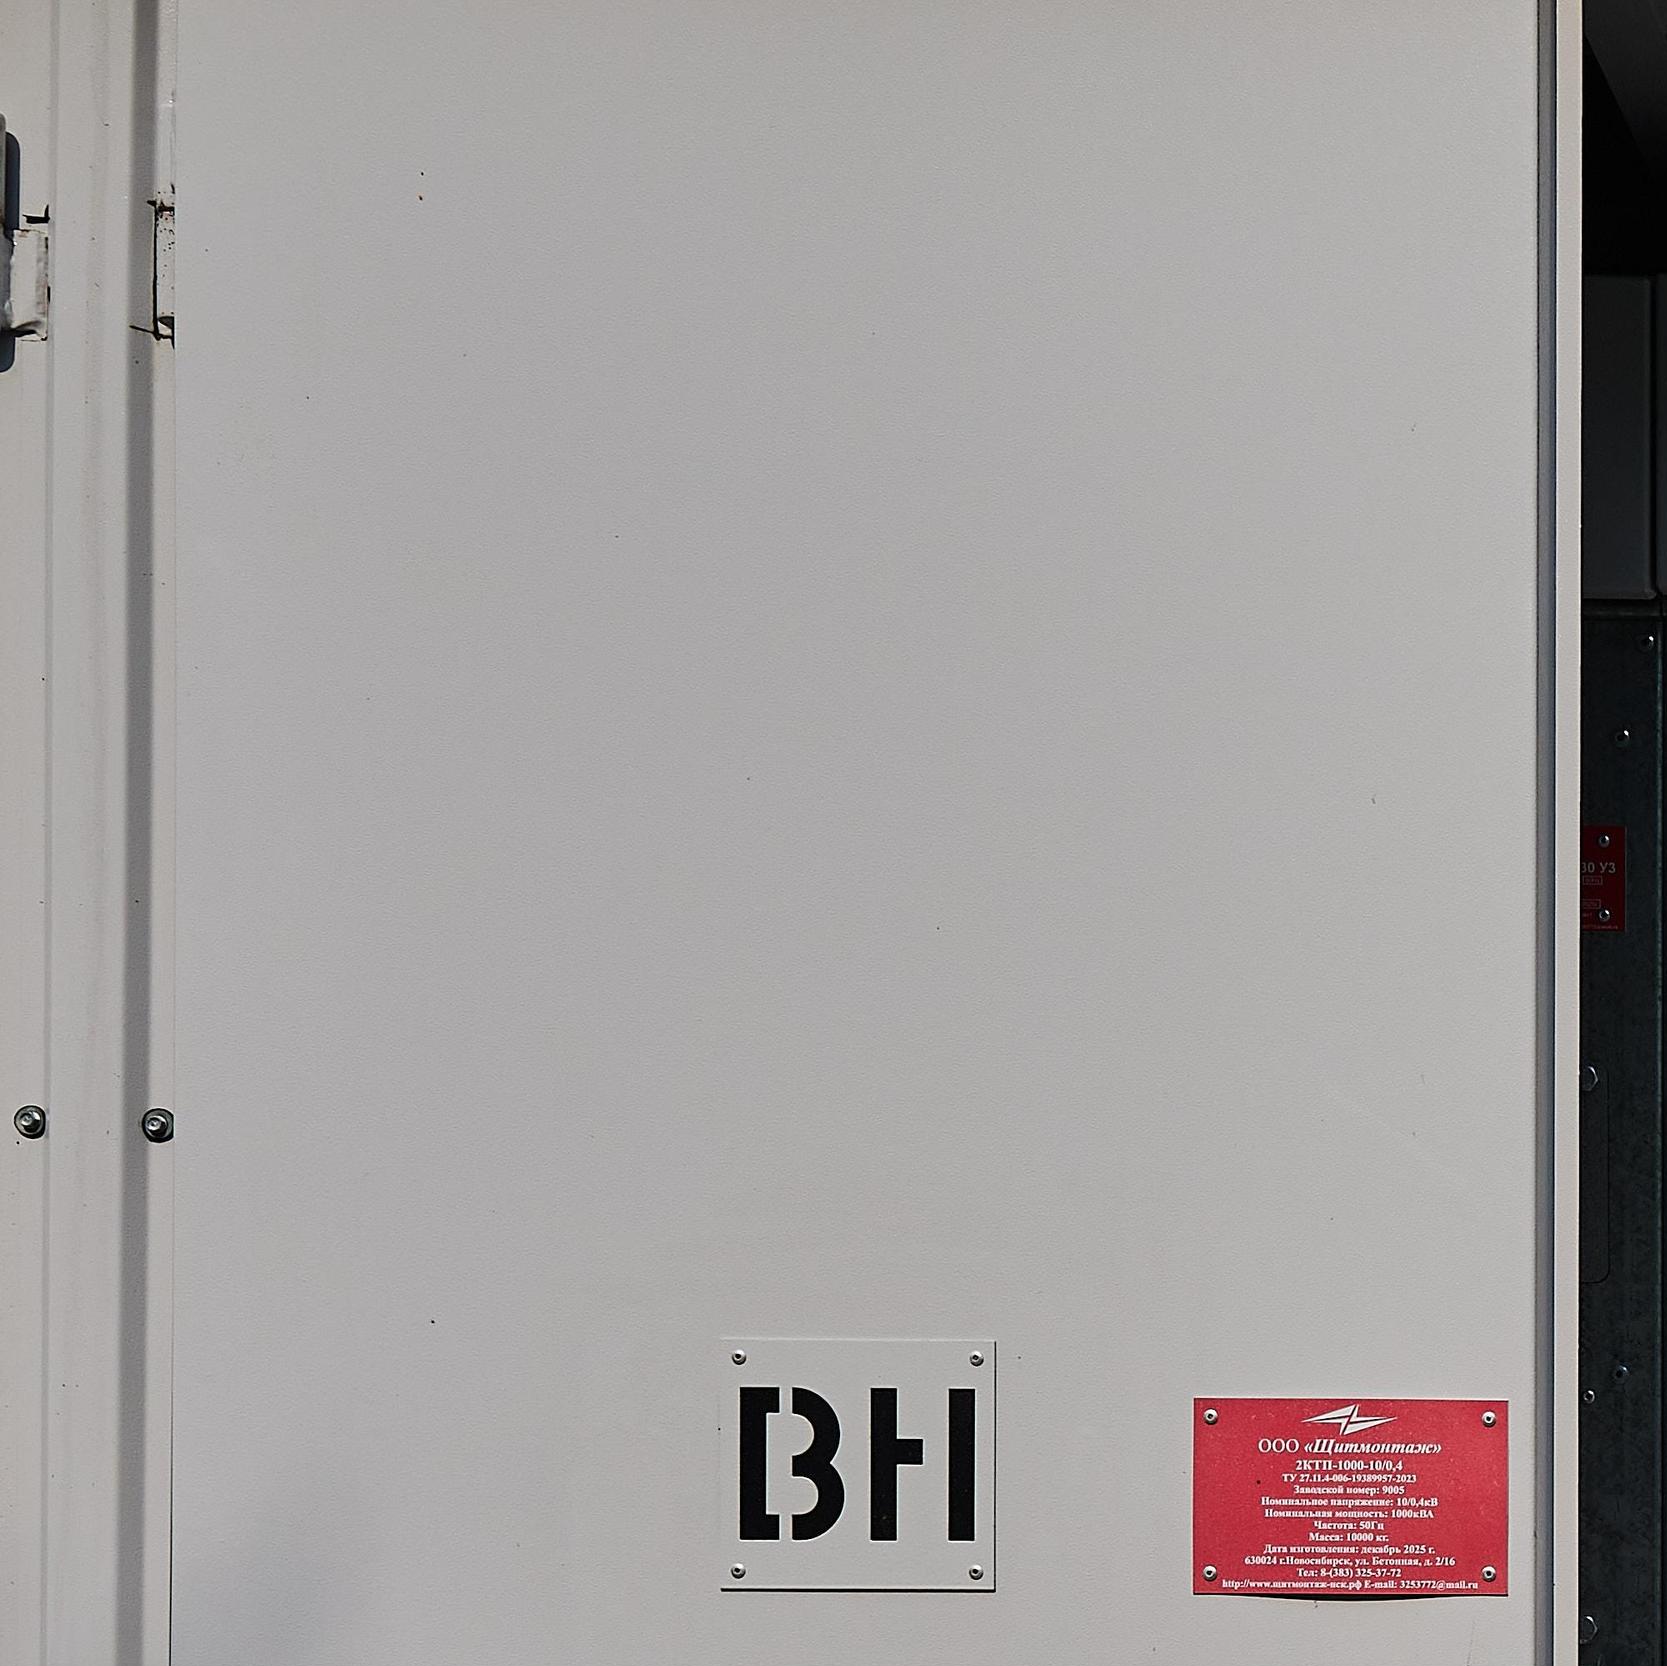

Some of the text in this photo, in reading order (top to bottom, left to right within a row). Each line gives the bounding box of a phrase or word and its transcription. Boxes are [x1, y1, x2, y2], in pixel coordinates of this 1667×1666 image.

[1258, 1438, 1441, 1456] ООО «Щитмонтаж»
[739, 1386, 976, 1541] ВН
[1295, 1460, 1403, 1472] 2КТП-1000-10/0,4
[1282, 1473, 1297, 1482] ТУ
[1294, 1485, 1405, 1497] Заводской номер: 9005
[1261, 1496, 1328, 1506] Номинальное
[1330, 1498, 1393, 1508] напряжение:
[1264, 1508, 1332, 1518] Номинальная
[1335, 1510, 1388, 1519] мощность:
[1313, 1520, 1384, 1532] Частота: 50Гц
[1308, 1531, 1343, 1541] Масса:
[1346, 1531, 1373, 1541] 10000
[1263, 1544, 1287, 1554] Дата
[1361, 1544, 1401, 1555] декабрь
[1403, 1544, 1426, 1554] 2025
[1244, 1556, 1277, 1565] 630024
[1435, 1556, 1456, 1566] 2/16
[1355, 1568, 1402, 1578] 325-37-72
